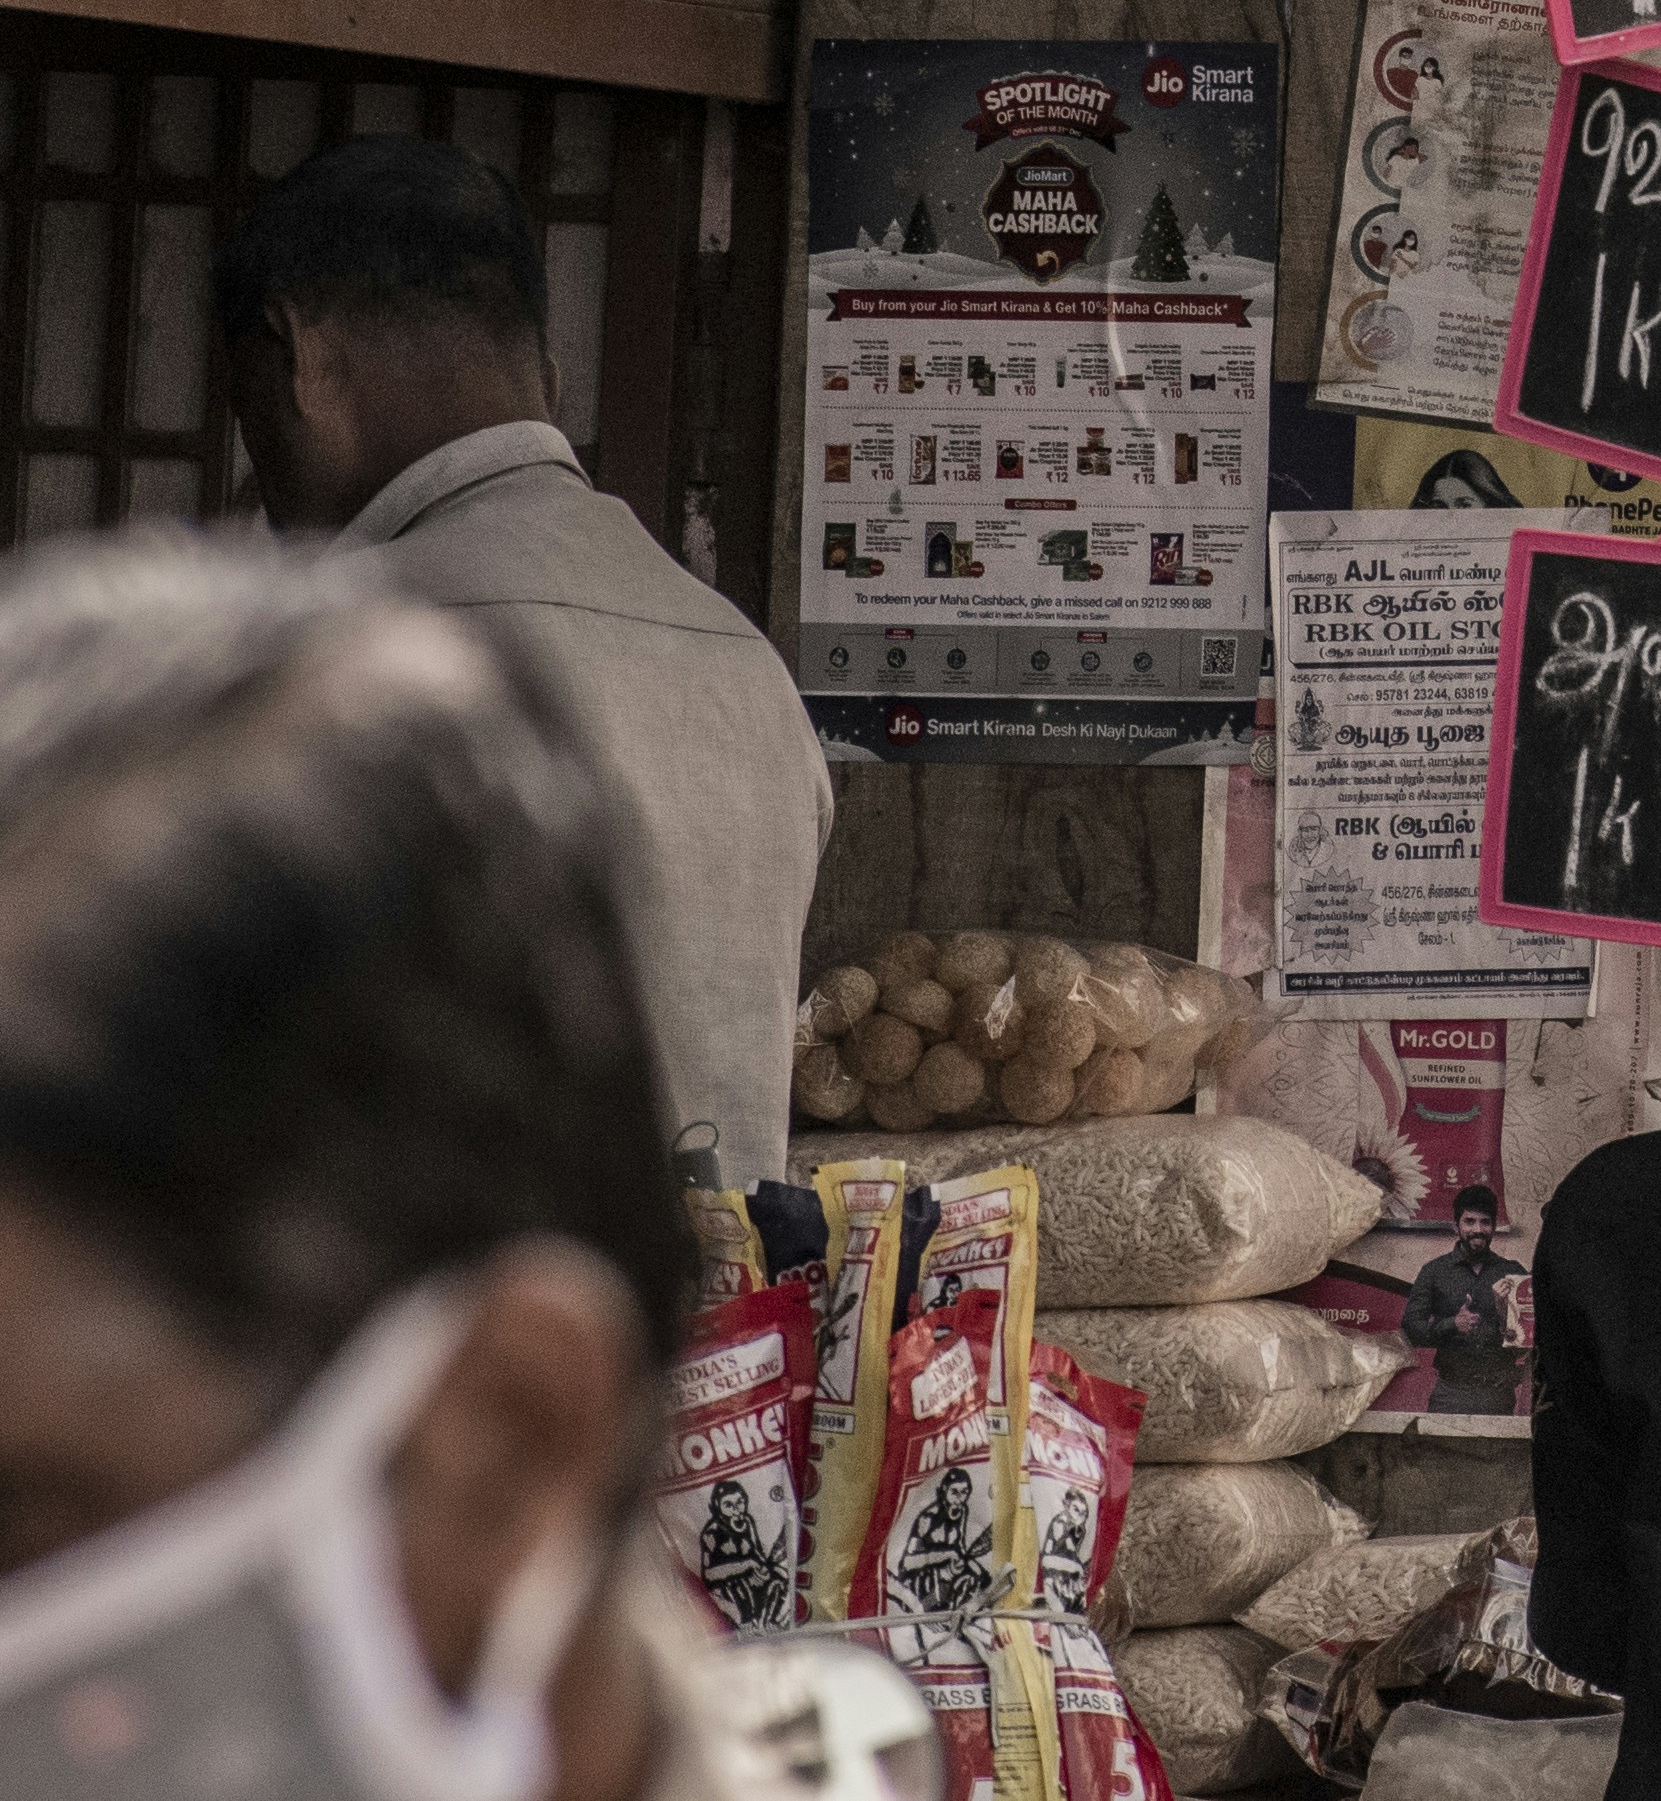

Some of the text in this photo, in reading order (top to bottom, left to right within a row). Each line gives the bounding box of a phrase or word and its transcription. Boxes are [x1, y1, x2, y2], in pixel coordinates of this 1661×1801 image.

[1147, 71, 1183, 93] Jio
[1192, 65, 1253, 85] Smart
[984, 82, 1111, 111] SPOTLIGHT
[1192, 84, 1254, 102] Kirana
[996, 106, 1098, 126] OF THE MONTH
[1024, 169, 1068, 182] JioMart
[1013, 190, 1078, 211] MAHA
[989, 213, 1099, 235] CASHBACK
[852, 299, 876, 313] Buy
[879, 299, 906, 312] from
[909, 301, 936, 315] your
[939, 299, 957, 313] Jio
[961, 299, 997, 313] Smart
[1001, 301, 1040, 314] Kirana
[1044, 302, 1052, 314] &
[1055, 302, 1077, 315] Get
[1112, 302, 1149, 315] Maha
[1344, 560, 1394, 582] AJL
[1399, 565, 1445, 582] பொரி
[1450, 564, 1501, 582] மண்டி
[855, 592, 1211, 609] To redeem your Maha Cashback, give missed call on 9212 999 888
[1292, 589, 1456, 621] RBK ஆயில்
[1305, 622, 1440, 643] RBK OIL
[1376, 688, 1488, 701] 95781 23244, 63819
[888, 717, 1176, 739] Jio Smart Kirana Desh Ki Nayi Dukaan
[1335, 724, 1484, 751] ஆயுத பூஜை
[1335, 818, 1380, 836] RBK
[1394, 839, 1465, 860] பொரி
[1399, 1029, 1495, 1049] Mr.GOLD
[1428, 1064, 1465, 1072] REFINED
[1412, 1075, 1481, 1084] SUNFLOWER OIL
